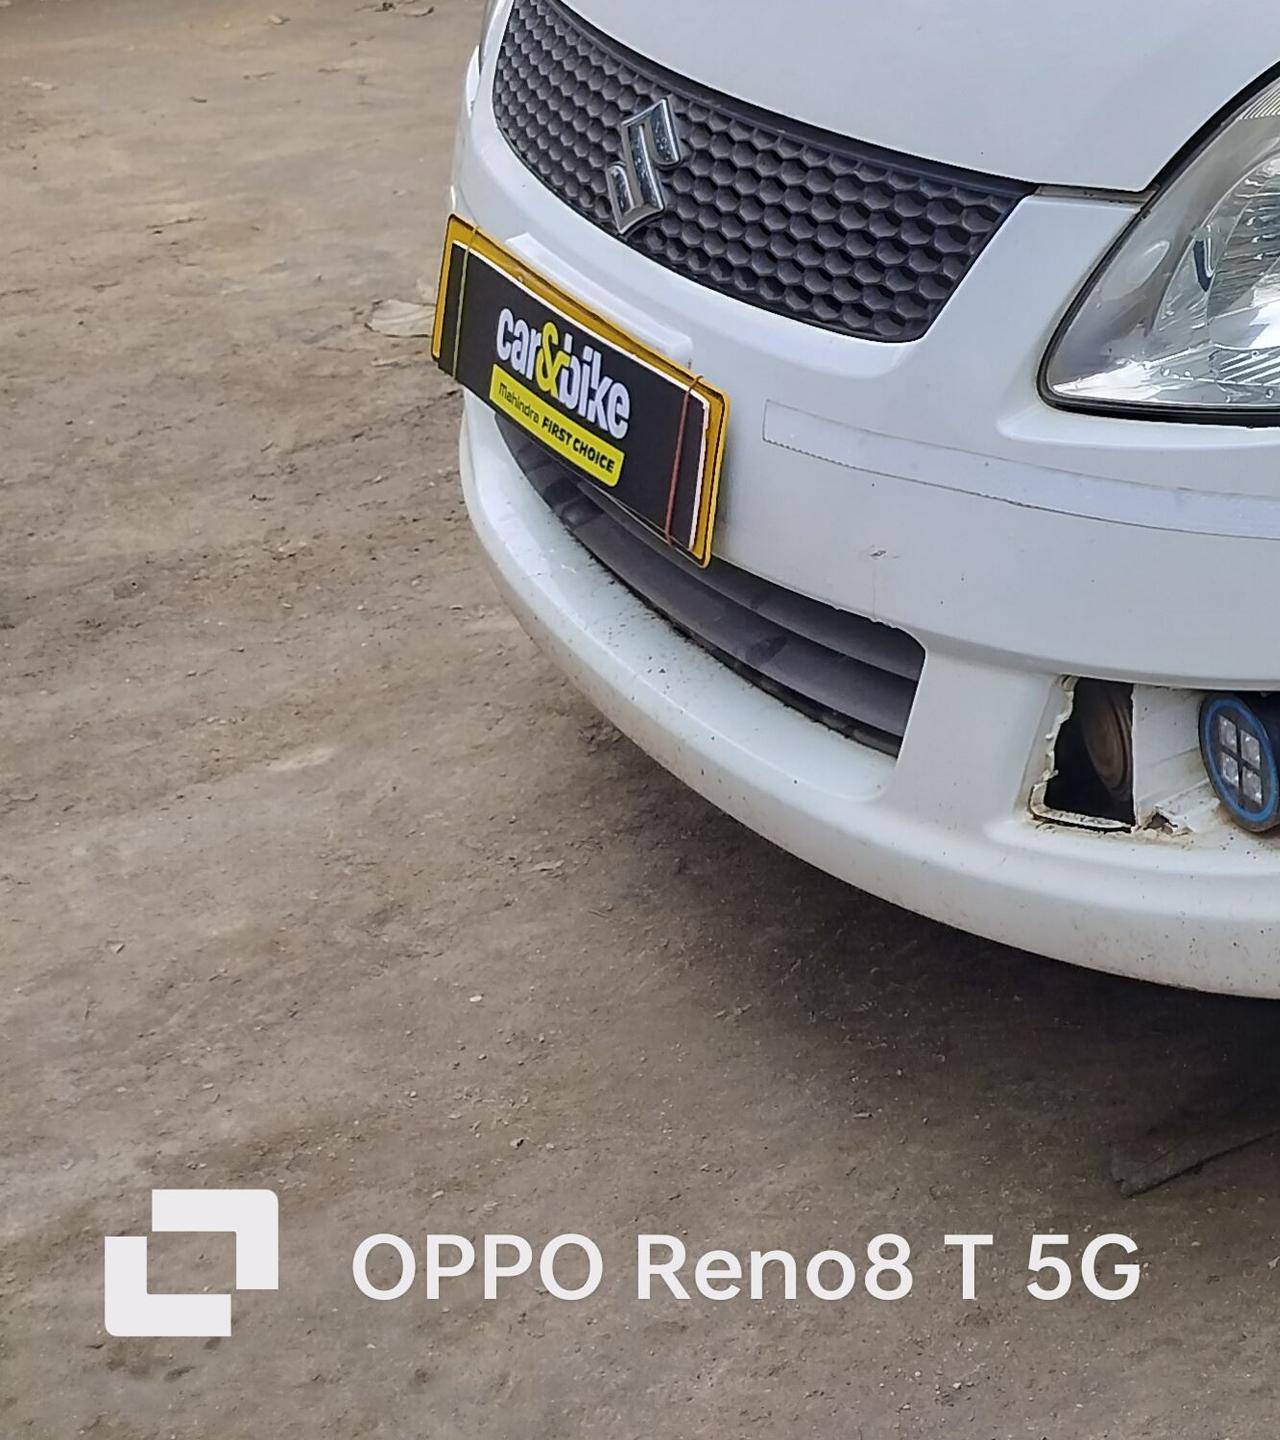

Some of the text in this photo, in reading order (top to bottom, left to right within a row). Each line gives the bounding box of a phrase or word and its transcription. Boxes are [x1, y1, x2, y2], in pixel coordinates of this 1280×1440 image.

[498, 382, 615, 473] Mahindra FIRST CHOICE
